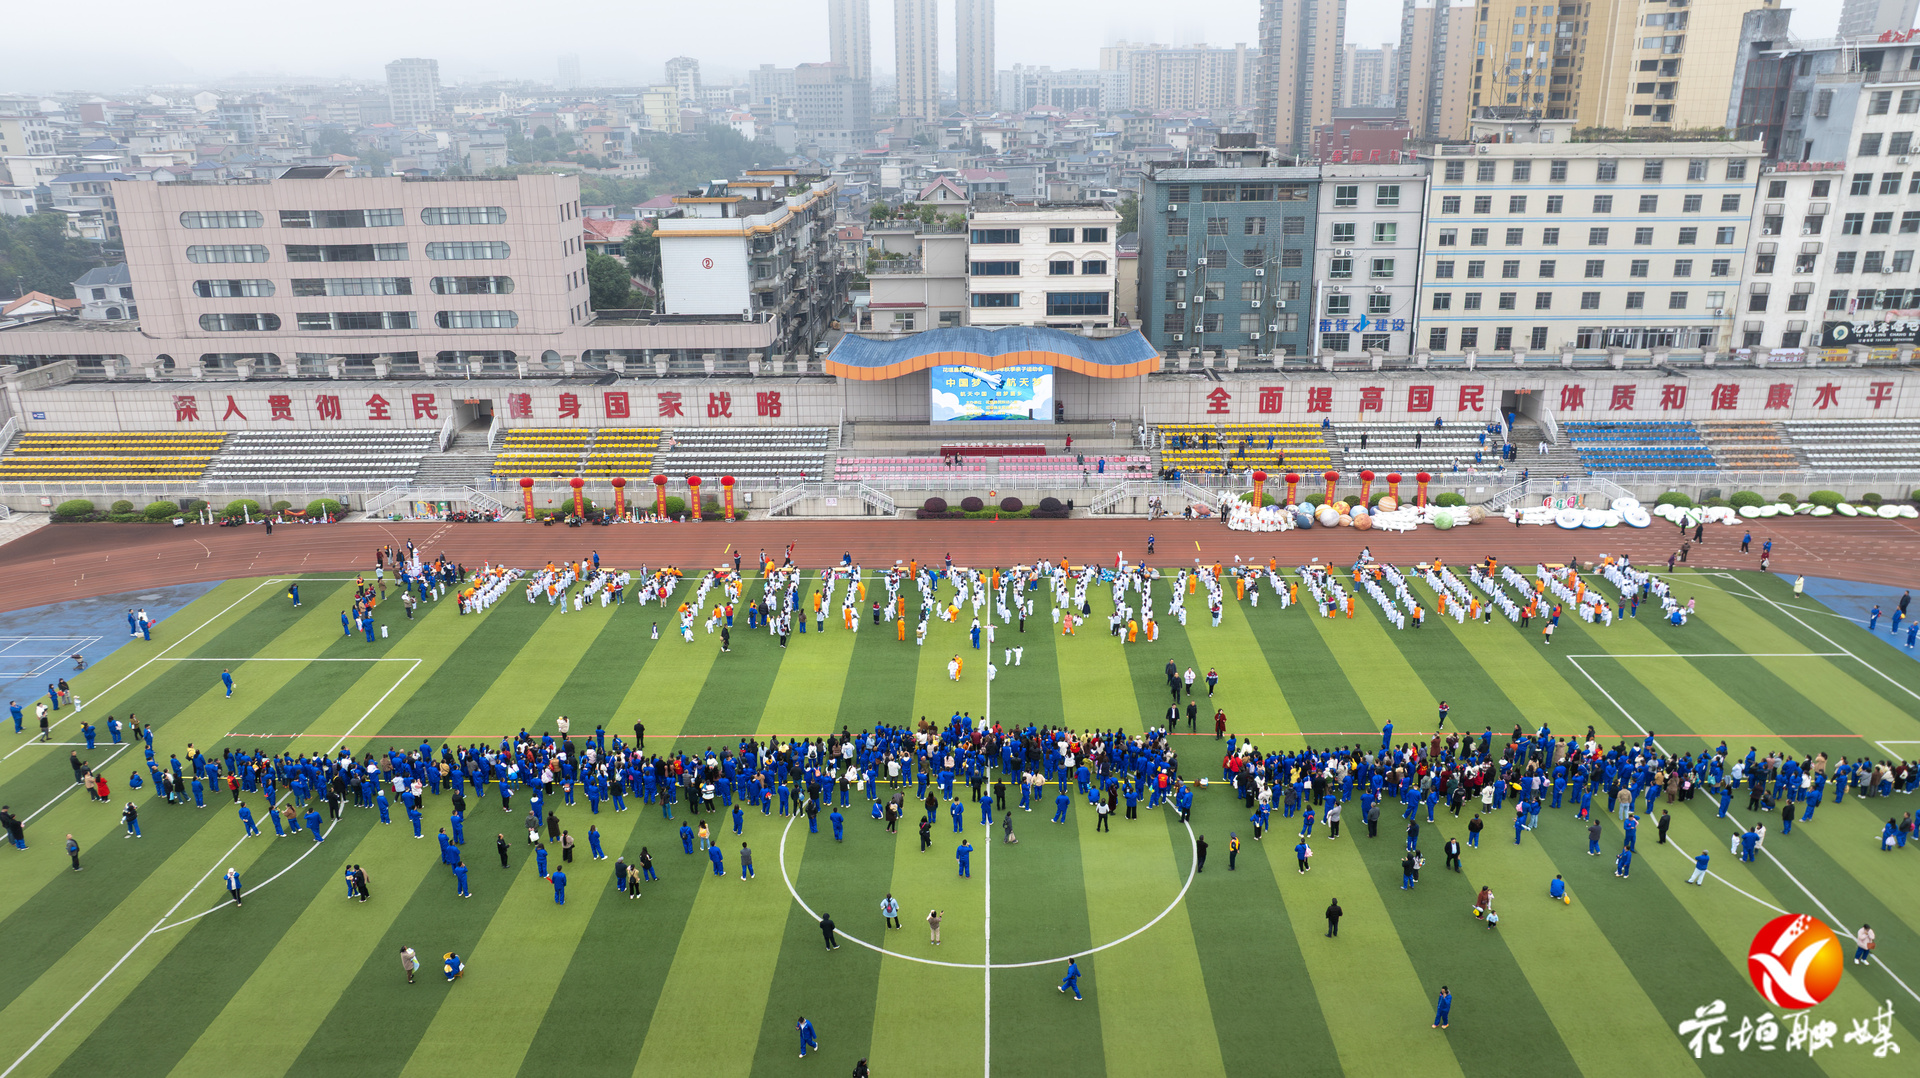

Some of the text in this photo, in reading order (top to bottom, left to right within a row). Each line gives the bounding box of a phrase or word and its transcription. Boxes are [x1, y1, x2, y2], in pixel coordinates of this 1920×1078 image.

[1320, 318, 1405, 332] 雷锋 建设
[946, 378, 1043, 388] 中国梦 航天梦
[1560, 382, 1894, 412] 体质和健康水平
[174, 393, 438, 423] 深入贯彻全民
[508, 391, 783, 420] 健身国家战略
[1206, 384, 1485, 415] 全面提高国民
